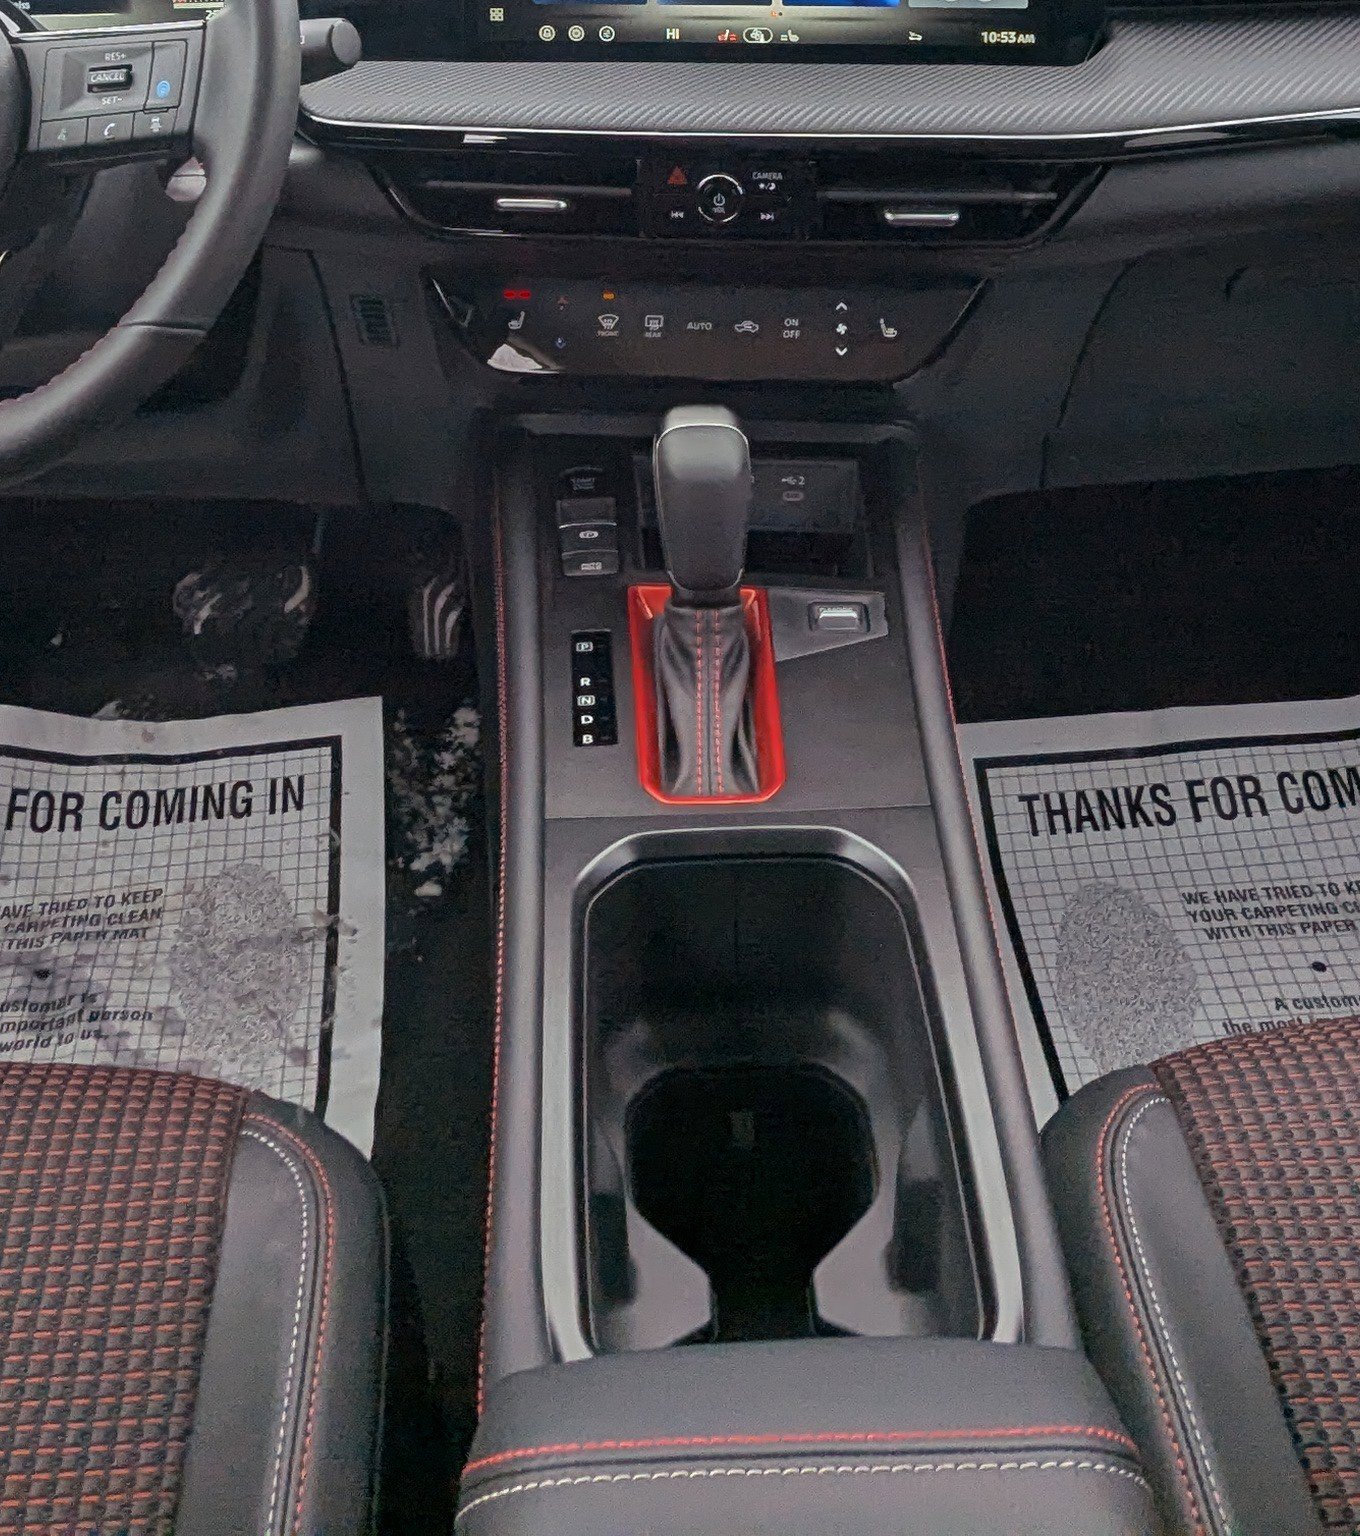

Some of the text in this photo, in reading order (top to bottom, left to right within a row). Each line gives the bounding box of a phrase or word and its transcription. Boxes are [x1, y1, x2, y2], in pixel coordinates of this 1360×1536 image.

[666, 29, 680, 40] HI
[981, 30, 1035, 44] 10:53 AM
[105, 52, 126, 61] RES+
[90, 72, 125, 83] CANCEL
[752, 171, 783, 181] CAMERA
[687, 322, 712, 330] AUTO
[784, 318, 799, 327] ON
[783, 330, 800, 339] OFF
[799, 476, 805, 486] 2
[579, 642, 590, 651] P
[580, 677, 591, 686] R
[581, 696, 592, 705] N
[580, 714, 593, 724] D
[582, 734, 593, 744] B
[4, 788, 84, 833] FOR
[98, 780, 254, 830] COMING
[267, 774, 306, 815] IN
[1019, 782, 1177, 837] THANKS
[1186, 775, 1268, 823] FOR
[1181, 891, 1210, 905] WE
[1214, 887, 1260, 904] HAVE
[1261, 884, 1314, 901] TRIED
[1317, 882, 1340, 897] TO
[39, 898, 88, 915] TRIED
[95, 894, 115, 908] TO
[120, 888, 164, 906] KEEP
[1186, 907, 1238, 923] YOUR
[1240, 901, 1338, 920] CARPETING
[4, 915, 100, 934] CARPETING
[107, 907, 165, 925] CLEAN
[1203, 925, 1251, 941] WITH
[1255, 922, 1296, 937] THIS
[1299, 919, 1358, 935] PAPER
[8, 936, 45, 950] THIS
[50, 929, 108, 945] PAPER
[111, 927, 150, 941] MAT
[80, 992, 98, 1004] is
[1274, 997, 1289, 1011] A
[87, 1010, 153, 1026] person
[1222, 1019, 1252, 1035] the
[0, 1034, 51, 1053] world
[57, 1032, 73, 1045] to
